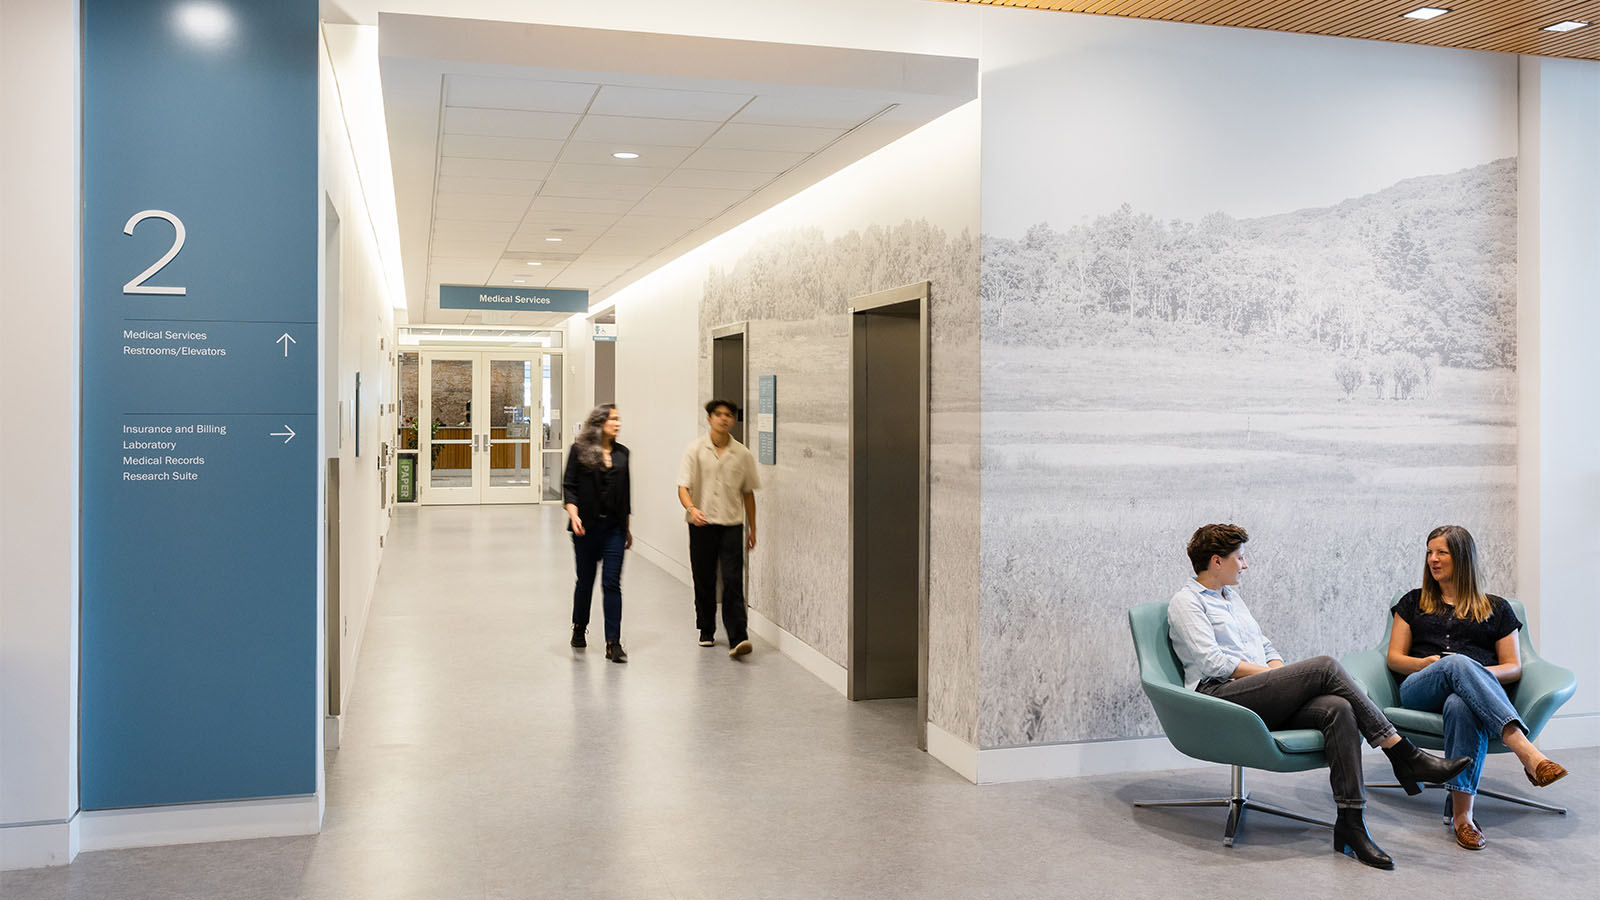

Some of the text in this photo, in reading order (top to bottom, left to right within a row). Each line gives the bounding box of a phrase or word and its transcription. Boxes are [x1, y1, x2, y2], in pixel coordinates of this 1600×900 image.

[122, 209, 187, 296] 2
[480, 294, 551, 304] Medical Services
[123, 330, 208, 341] Medical Services
[123, 345, 227, 357] Restrooms/Elevators
[123, 424, 227, 436] Insurance and Billing
[123, 440, 177, 451] Laboratory
[123, 455, 205, 465] Medical Records
[123, 471, 199, 481] Research Suite
[401, 465, 410, 497] PAPER
